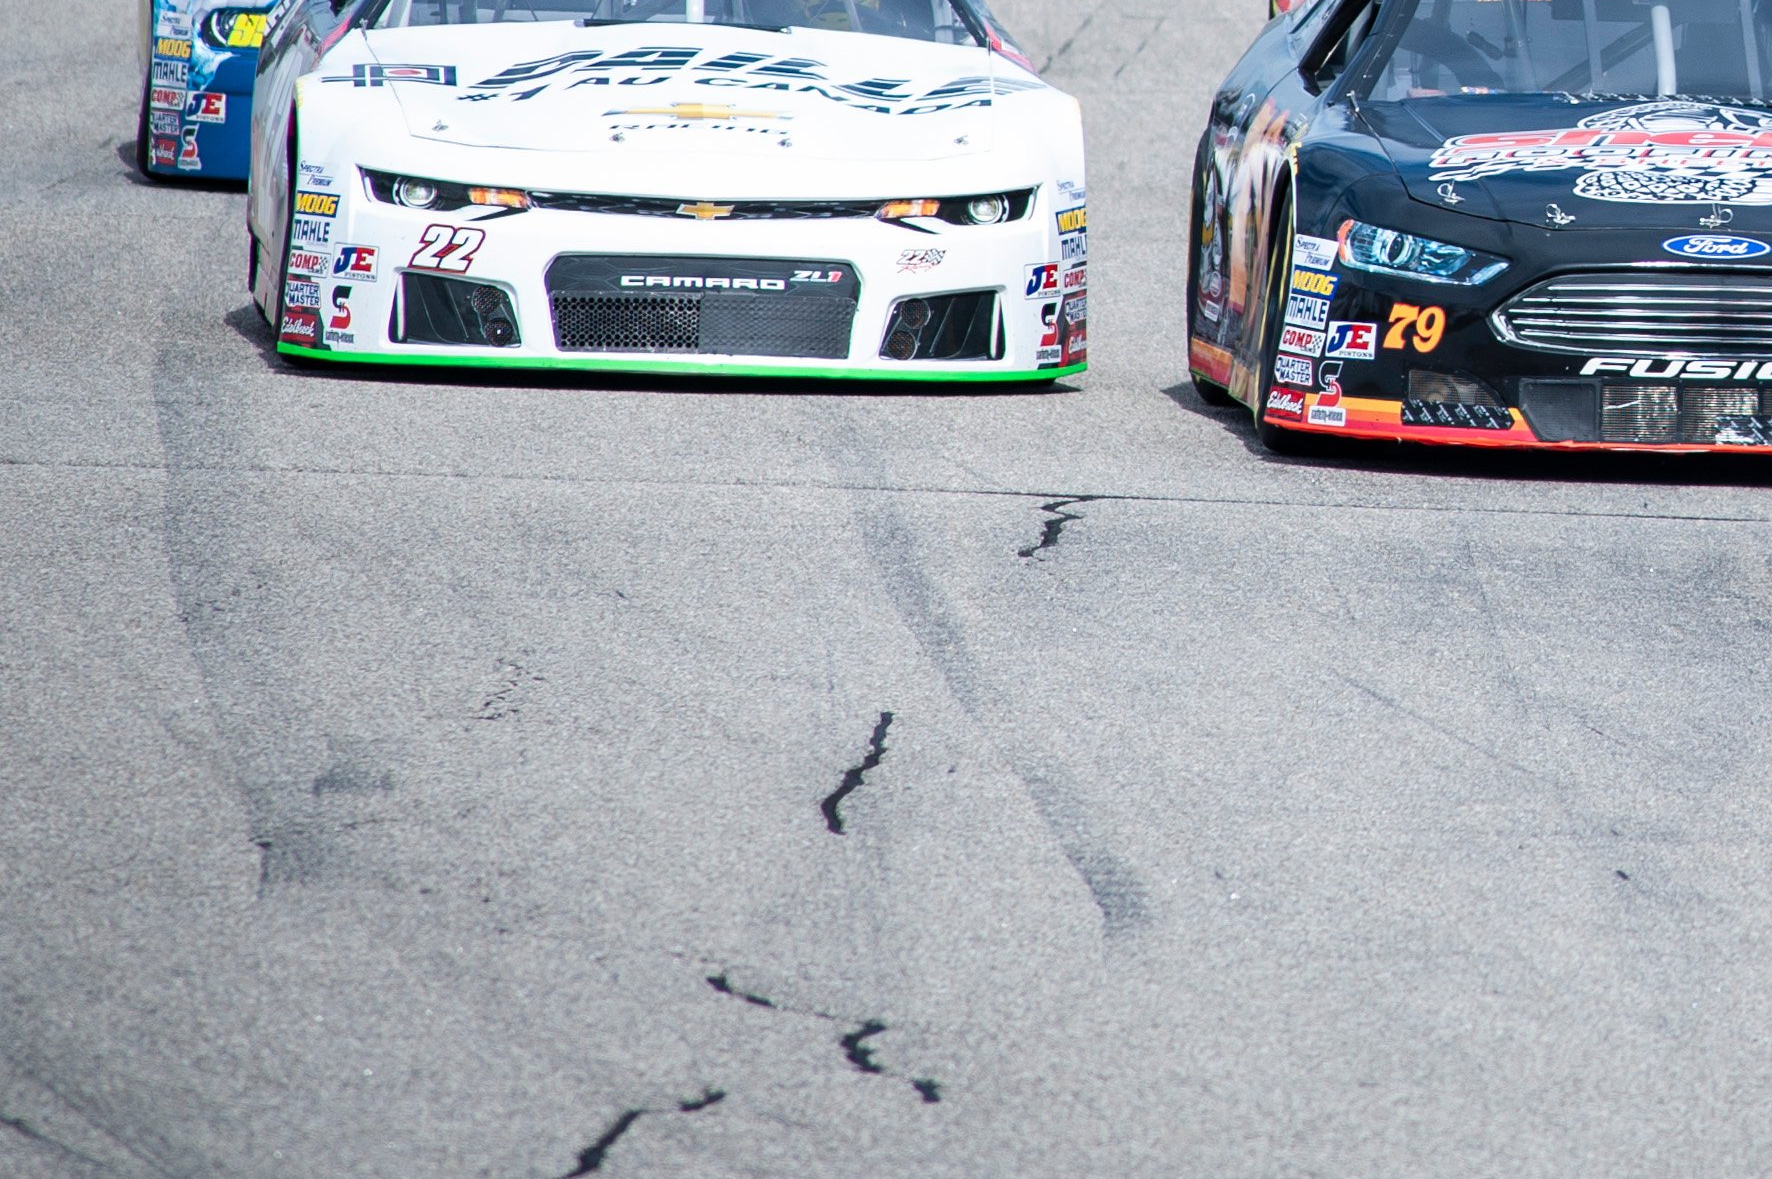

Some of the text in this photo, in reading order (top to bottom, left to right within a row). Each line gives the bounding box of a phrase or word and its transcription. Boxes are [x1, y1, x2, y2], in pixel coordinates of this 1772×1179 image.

[158, 39, 192, 58] MOOG
[153, 62, 187, 83] MAHLE
[187, 92, 223, 118] JE
[565, 76, 672, 90] AU
[695, 77, 992, 115] CANADA
[296, 193, 337, 215] MOOG
[293, 219, 330, 242] MAHLE
[407, 223, 486, 273] 22
[1683, 236, 1749, 257] Ford
[289, 253, 319, 271] COMP
[333, 247, 375, 274] JE
[286, 282, 319, 295] QUARTER
[621, 269, 843, 291] CAMARO ZL1
[1027, 263, 1058, 296] JE
[1293, 269, 1338, 297] MOOG
[288, 294, 320, 307] MASTER
[1286, 295, 1329, 324] MAHLE
[1282, 329, 1313, 348] COMP
[1327, 324, 1372, 354] JE
[1382, 303, 1446, 353] 79
[1276, 357, 1310, 373] QUARTER
[1338, 350, 1374, 359] PISTONS
[1279, 369, 1311, 384] MASTER
[1266, 390, 1303, 414] Edelbrock
